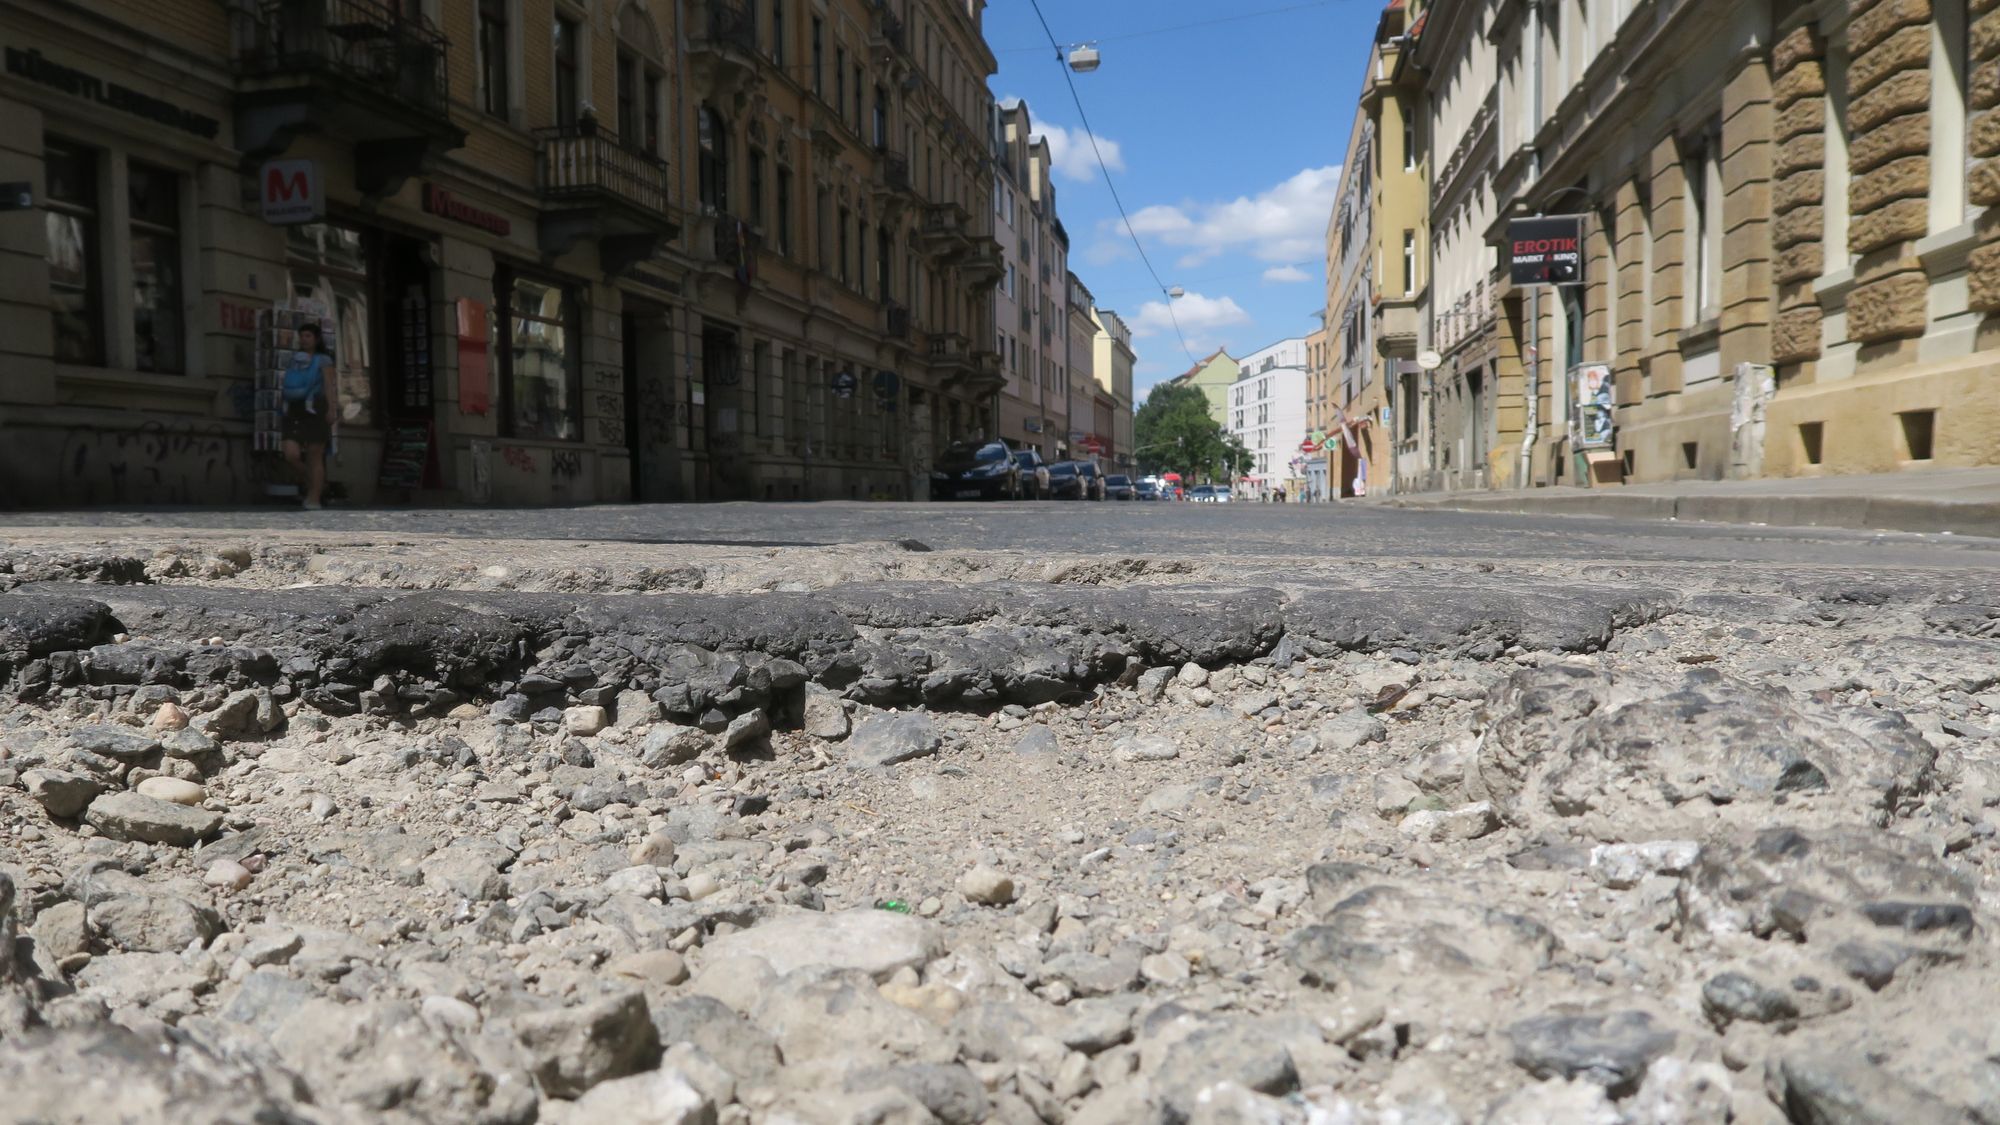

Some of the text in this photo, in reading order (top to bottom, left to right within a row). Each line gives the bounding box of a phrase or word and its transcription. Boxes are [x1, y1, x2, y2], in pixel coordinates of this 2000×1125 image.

[267, 168, 308, 203] M
[1513, 238, 1577, 255] EROTIK
[1513, 254, 1544, 264] MARKT
[1553, 252, 1578, 261] KINO
